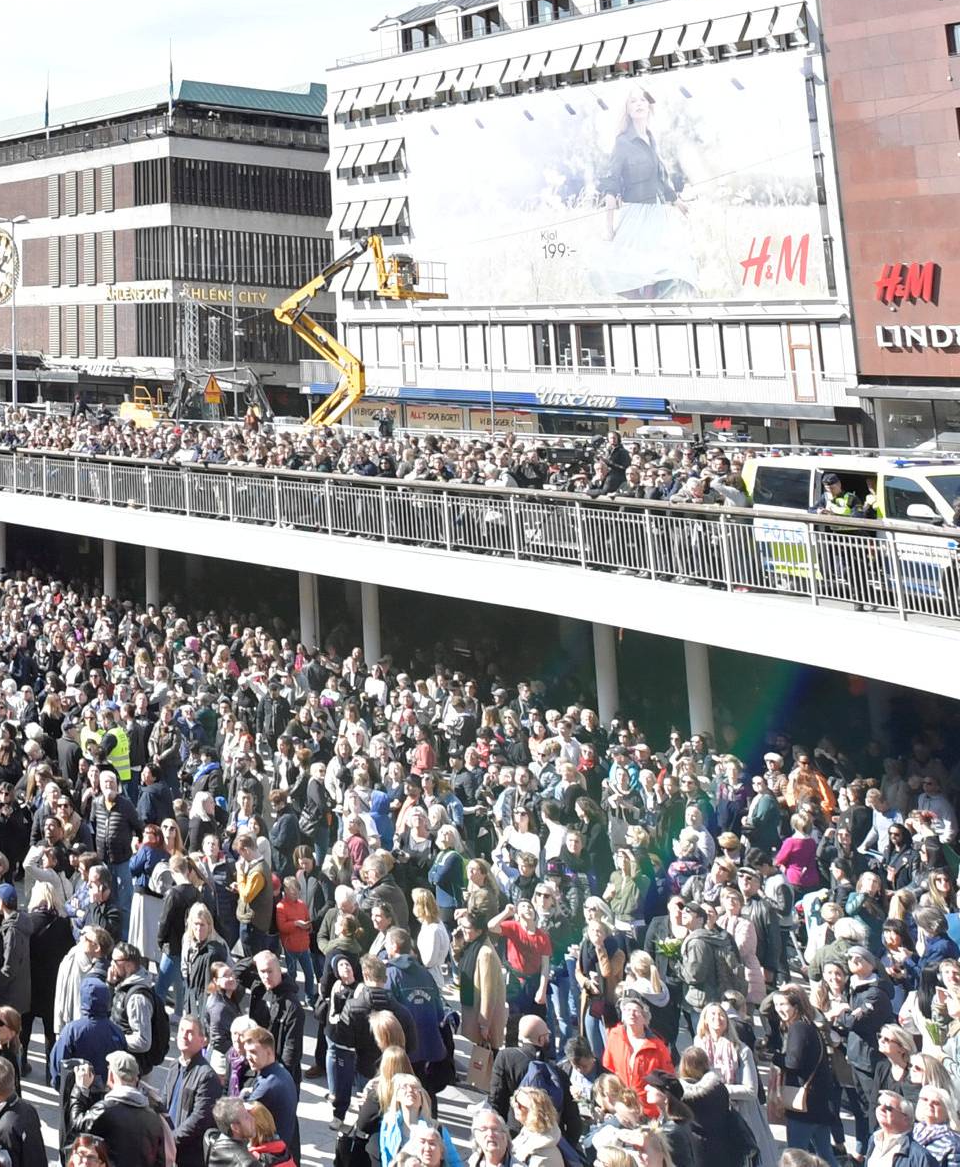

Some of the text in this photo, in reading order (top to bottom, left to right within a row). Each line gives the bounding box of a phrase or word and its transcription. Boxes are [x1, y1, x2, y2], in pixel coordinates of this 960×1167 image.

[542, 242, 577, 259] 199:-
[739, 233, 810, 287] H&M
[873, 260, 937, 303] H&M
[238, 290, 268, 304] CITY
[875, 324, 960, 347] LIND
